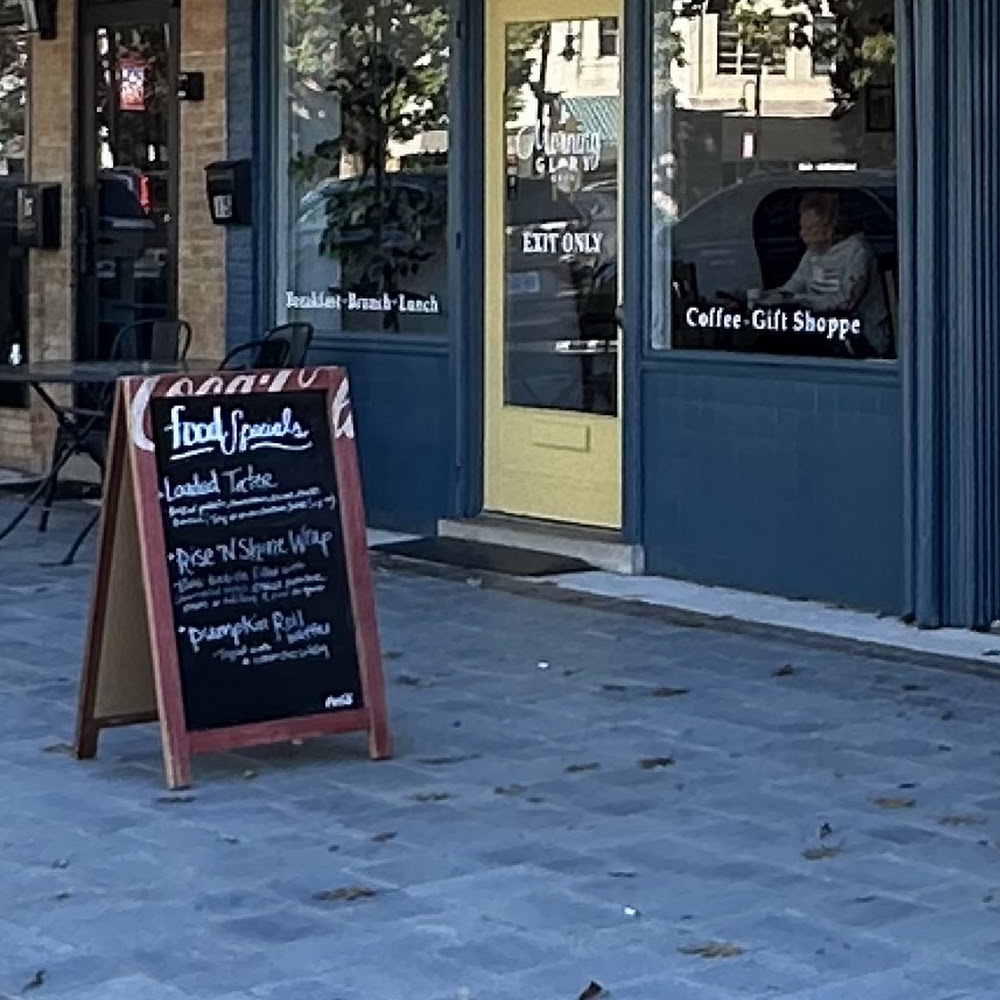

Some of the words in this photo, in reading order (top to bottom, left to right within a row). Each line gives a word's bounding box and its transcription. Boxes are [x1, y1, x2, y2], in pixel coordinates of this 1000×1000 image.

[523, 232, 560, 253] EXIT
[562, 232, 604, 253] ONLY
[399, 293, 440, 313] Lunch
[686, 306, 742, 328] Coffee
[751, 308, 788, 332] Gift
[792, 309, 861, 340] Shoppe
